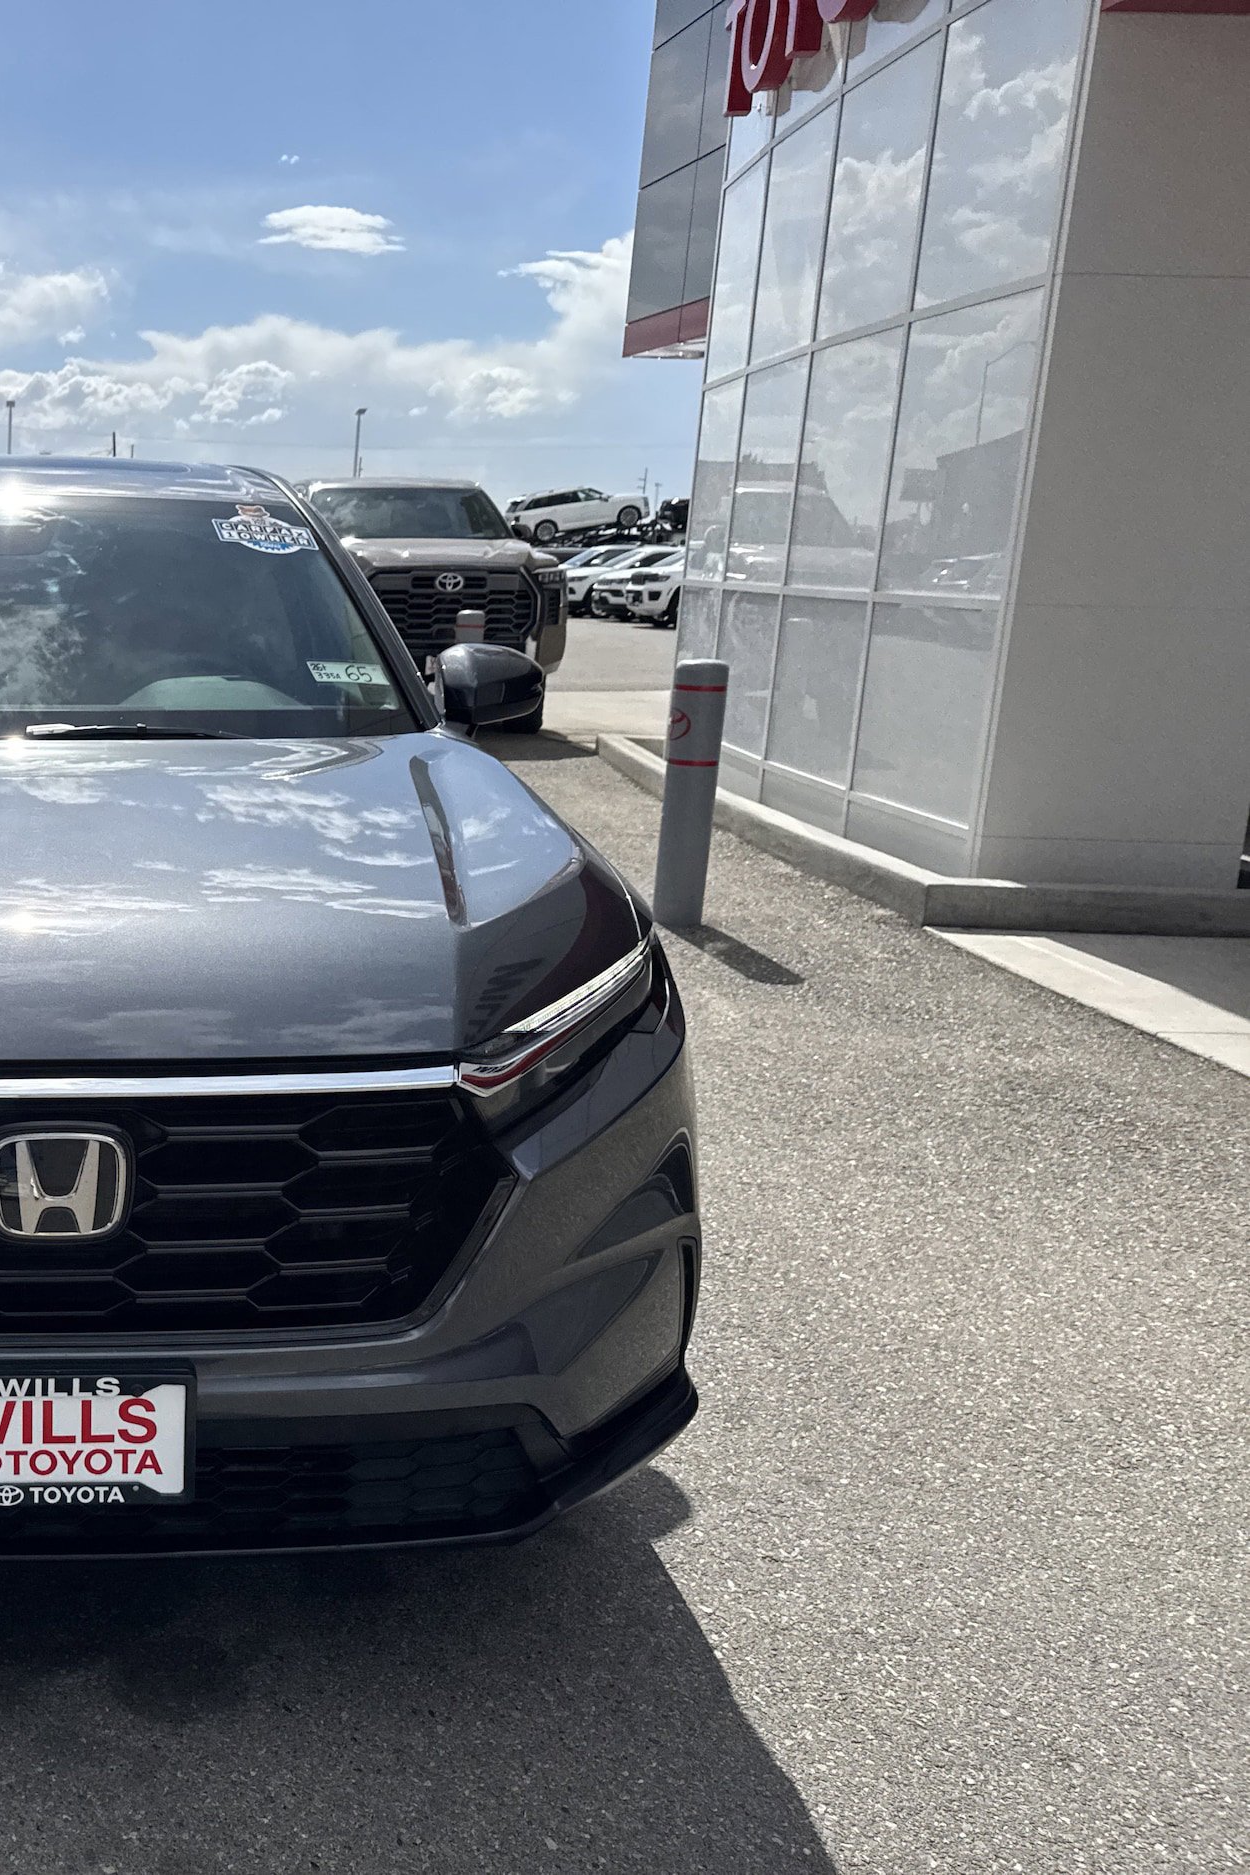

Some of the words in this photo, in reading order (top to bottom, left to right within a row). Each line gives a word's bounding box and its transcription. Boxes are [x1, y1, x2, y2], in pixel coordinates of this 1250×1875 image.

[221, 523, 309, 540] CARFAX
[240, 532, 309, 546] OWNER
[345, 664, 372, 682] 65
[5, 1449, 163, 1476] TOYOTA
[29, 1486, 125, 1504] TOYOTA
